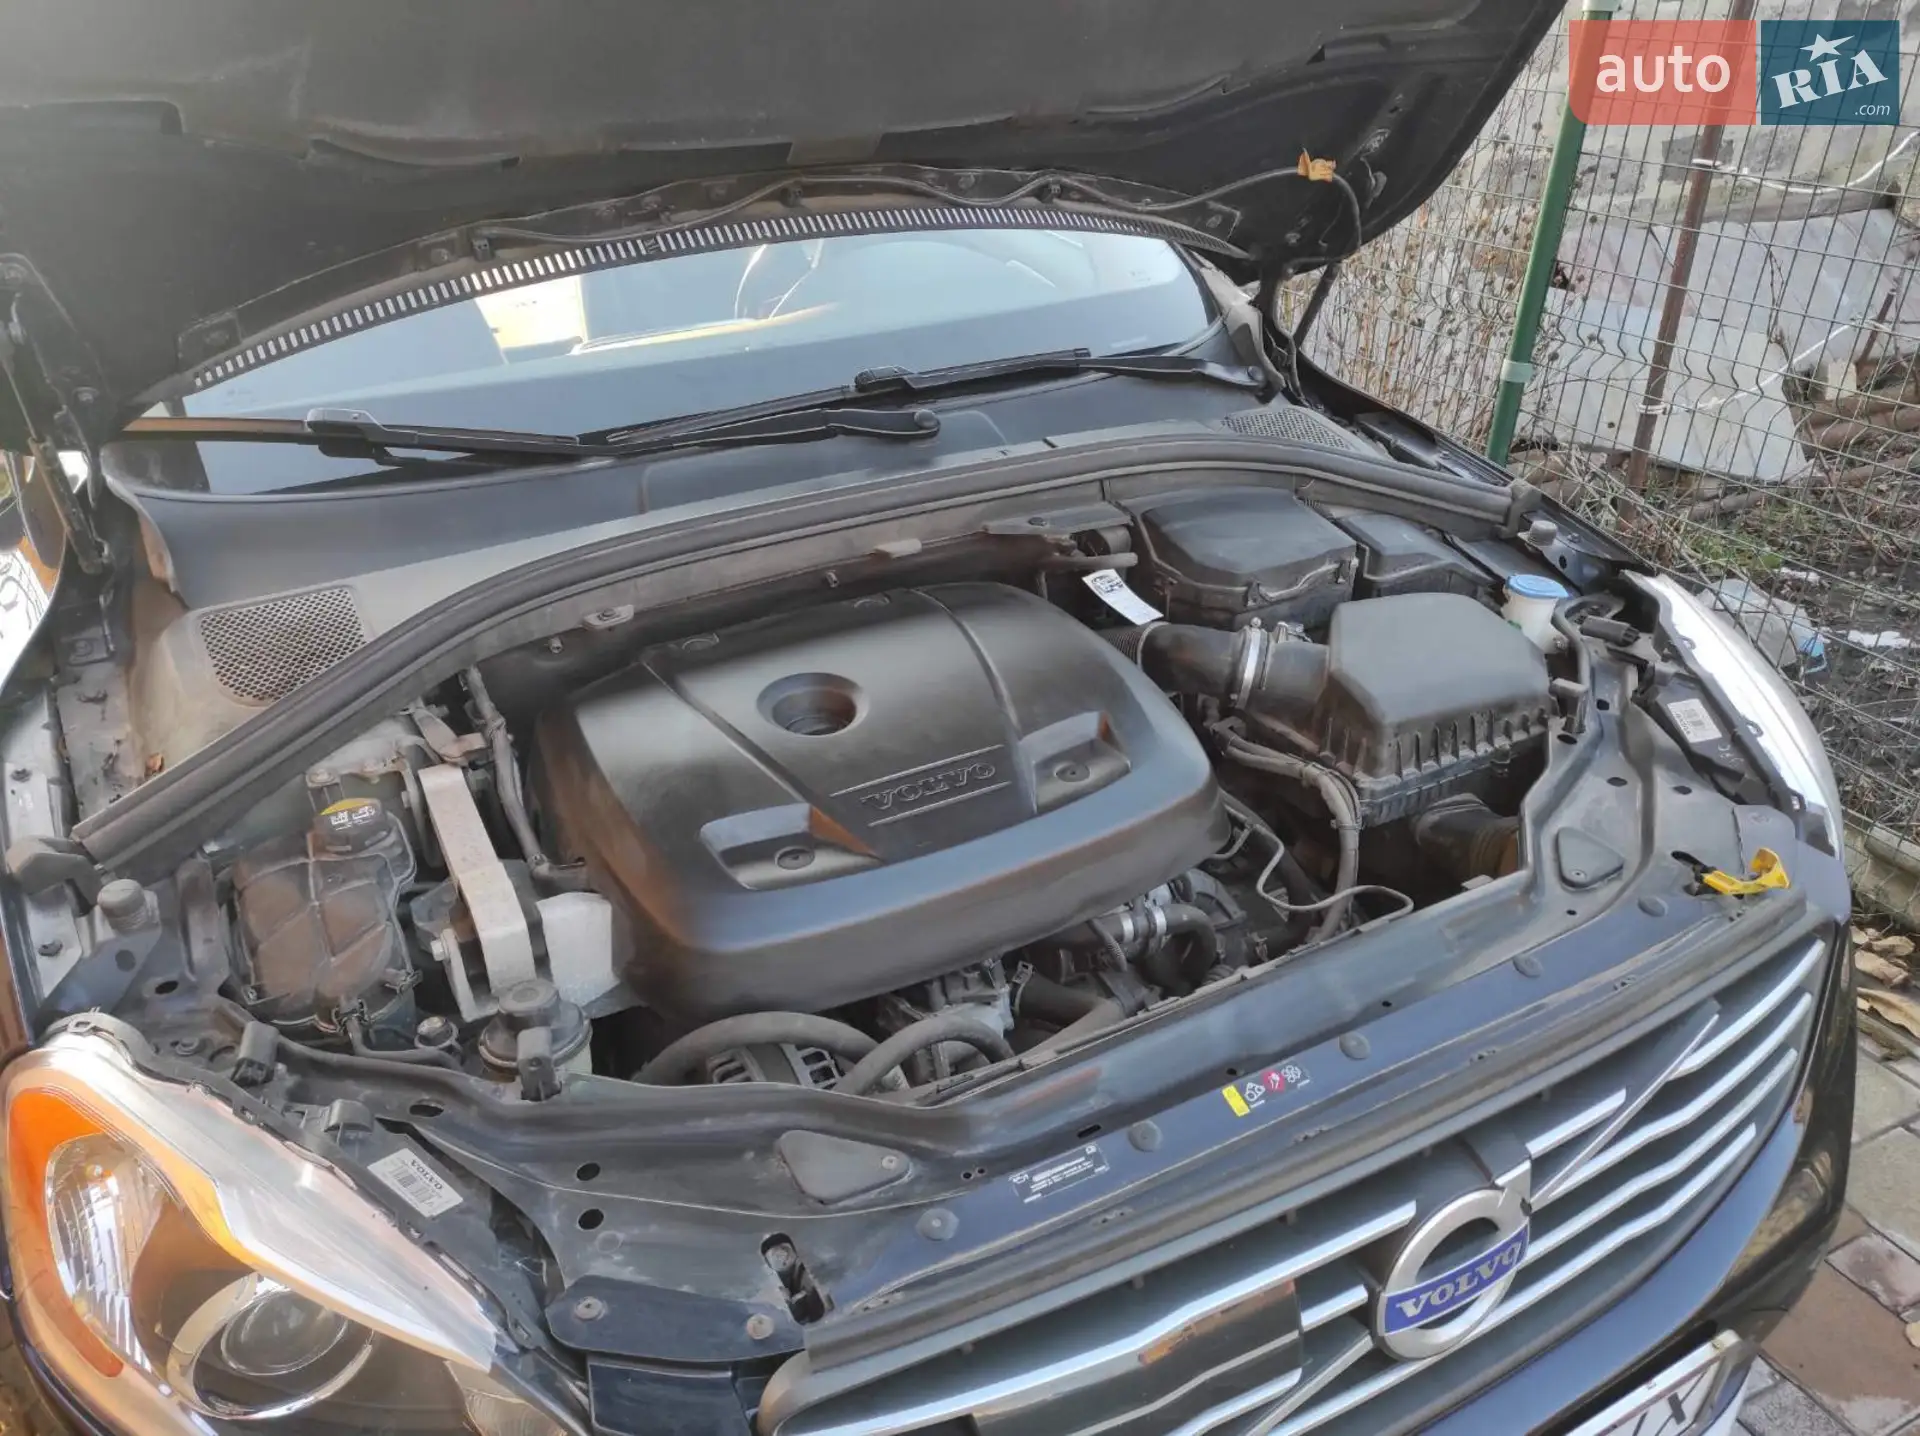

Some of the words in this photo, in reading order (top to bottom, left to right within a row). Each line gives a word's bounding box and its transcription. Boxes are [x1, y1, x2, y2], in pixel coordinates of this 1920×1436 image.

[860, 763, 996, 810] VOLVO
[411, 1159, 443, 1190] VOLVO
[1396, 1241, 1522, 1318] VOLVO
